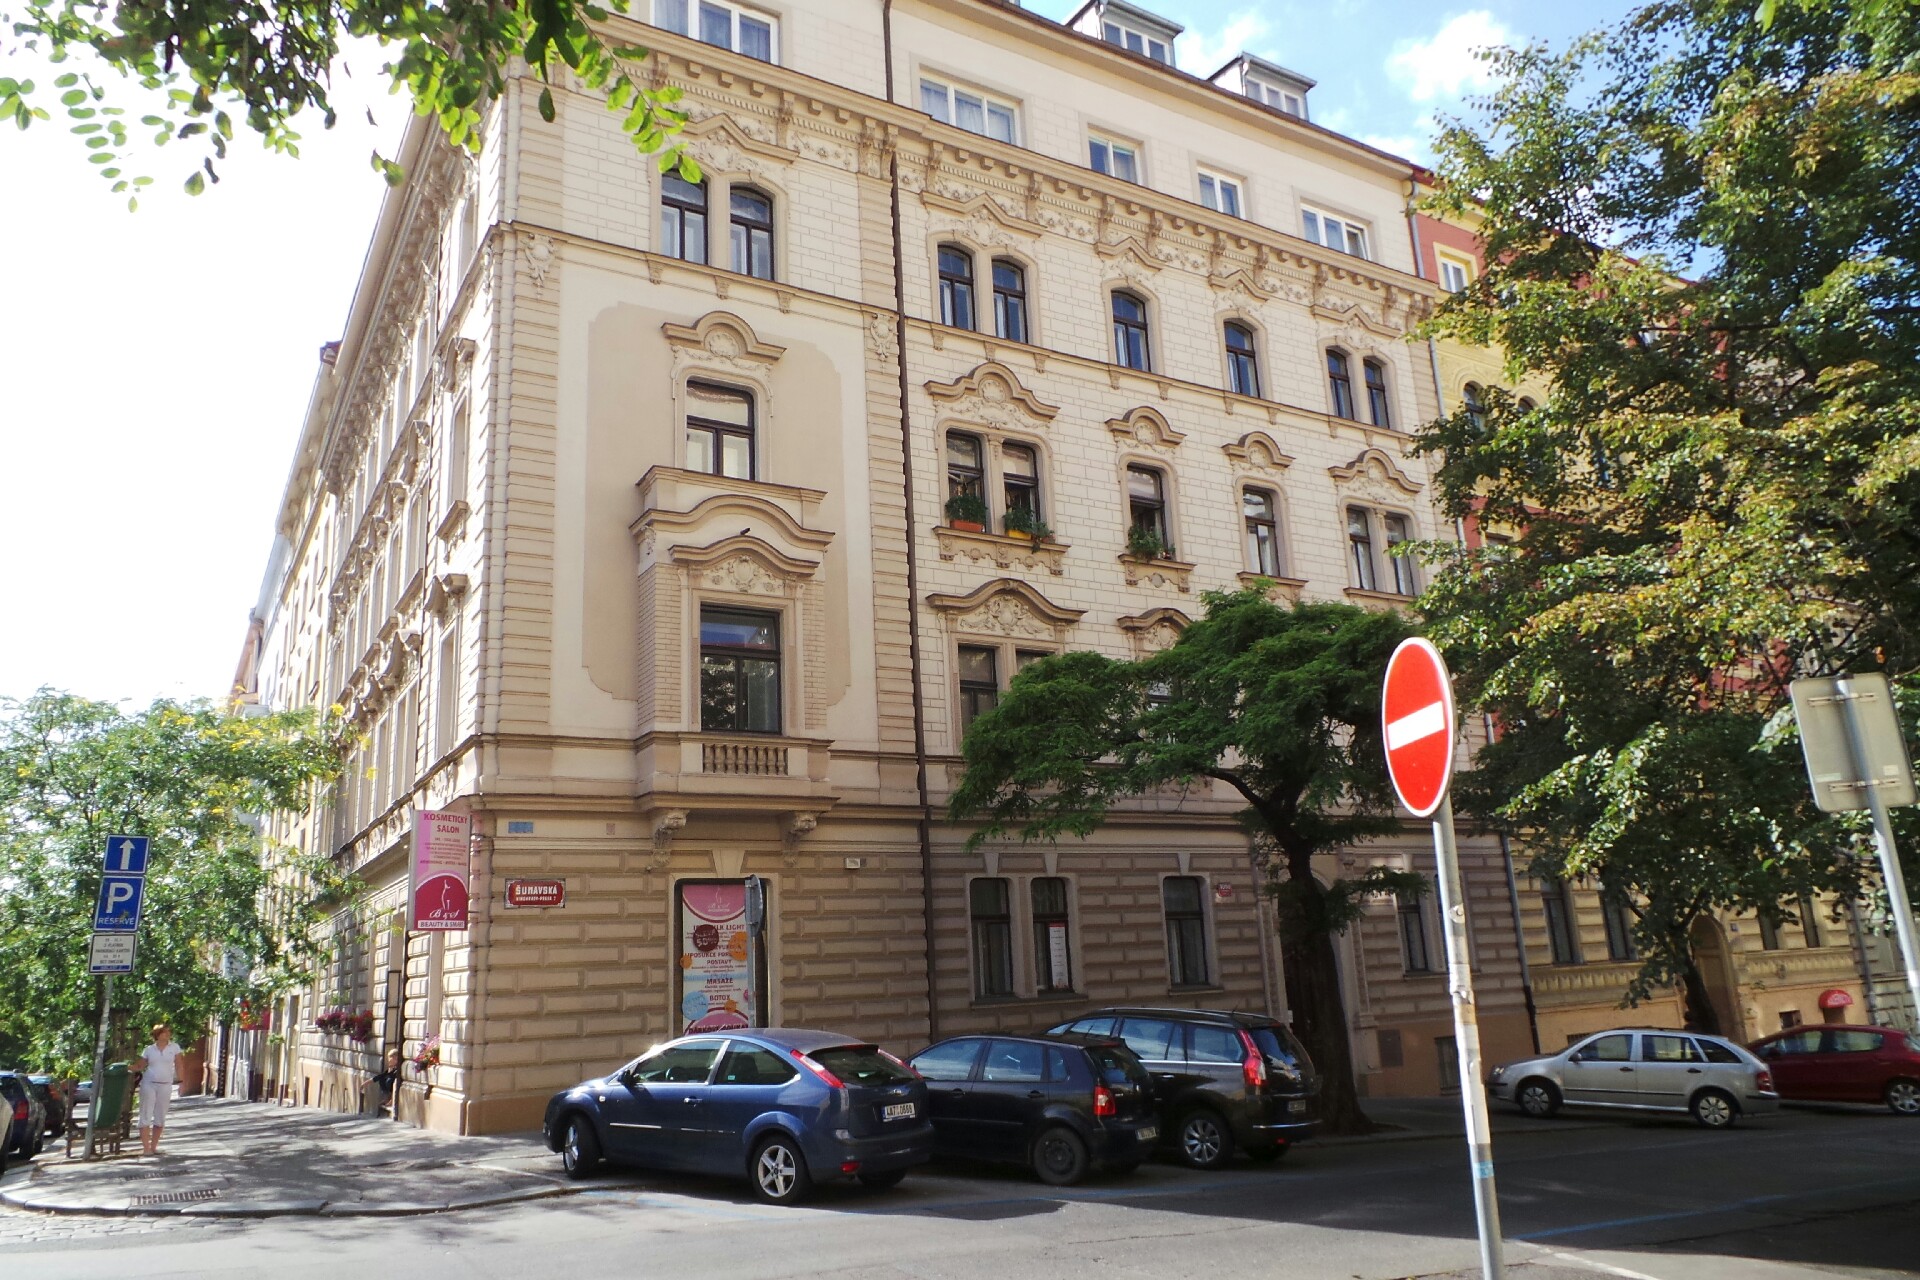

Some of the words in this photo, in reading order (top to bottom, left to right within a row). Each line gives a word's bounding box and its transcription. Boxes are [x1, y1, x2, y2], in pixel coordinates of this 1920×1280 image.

[423, 813, 467, 825] KOSMETICKÝ
[436, 825, 460, 834] SALON
[515, 884, 558, 895] ŠUMAVSKÁ
